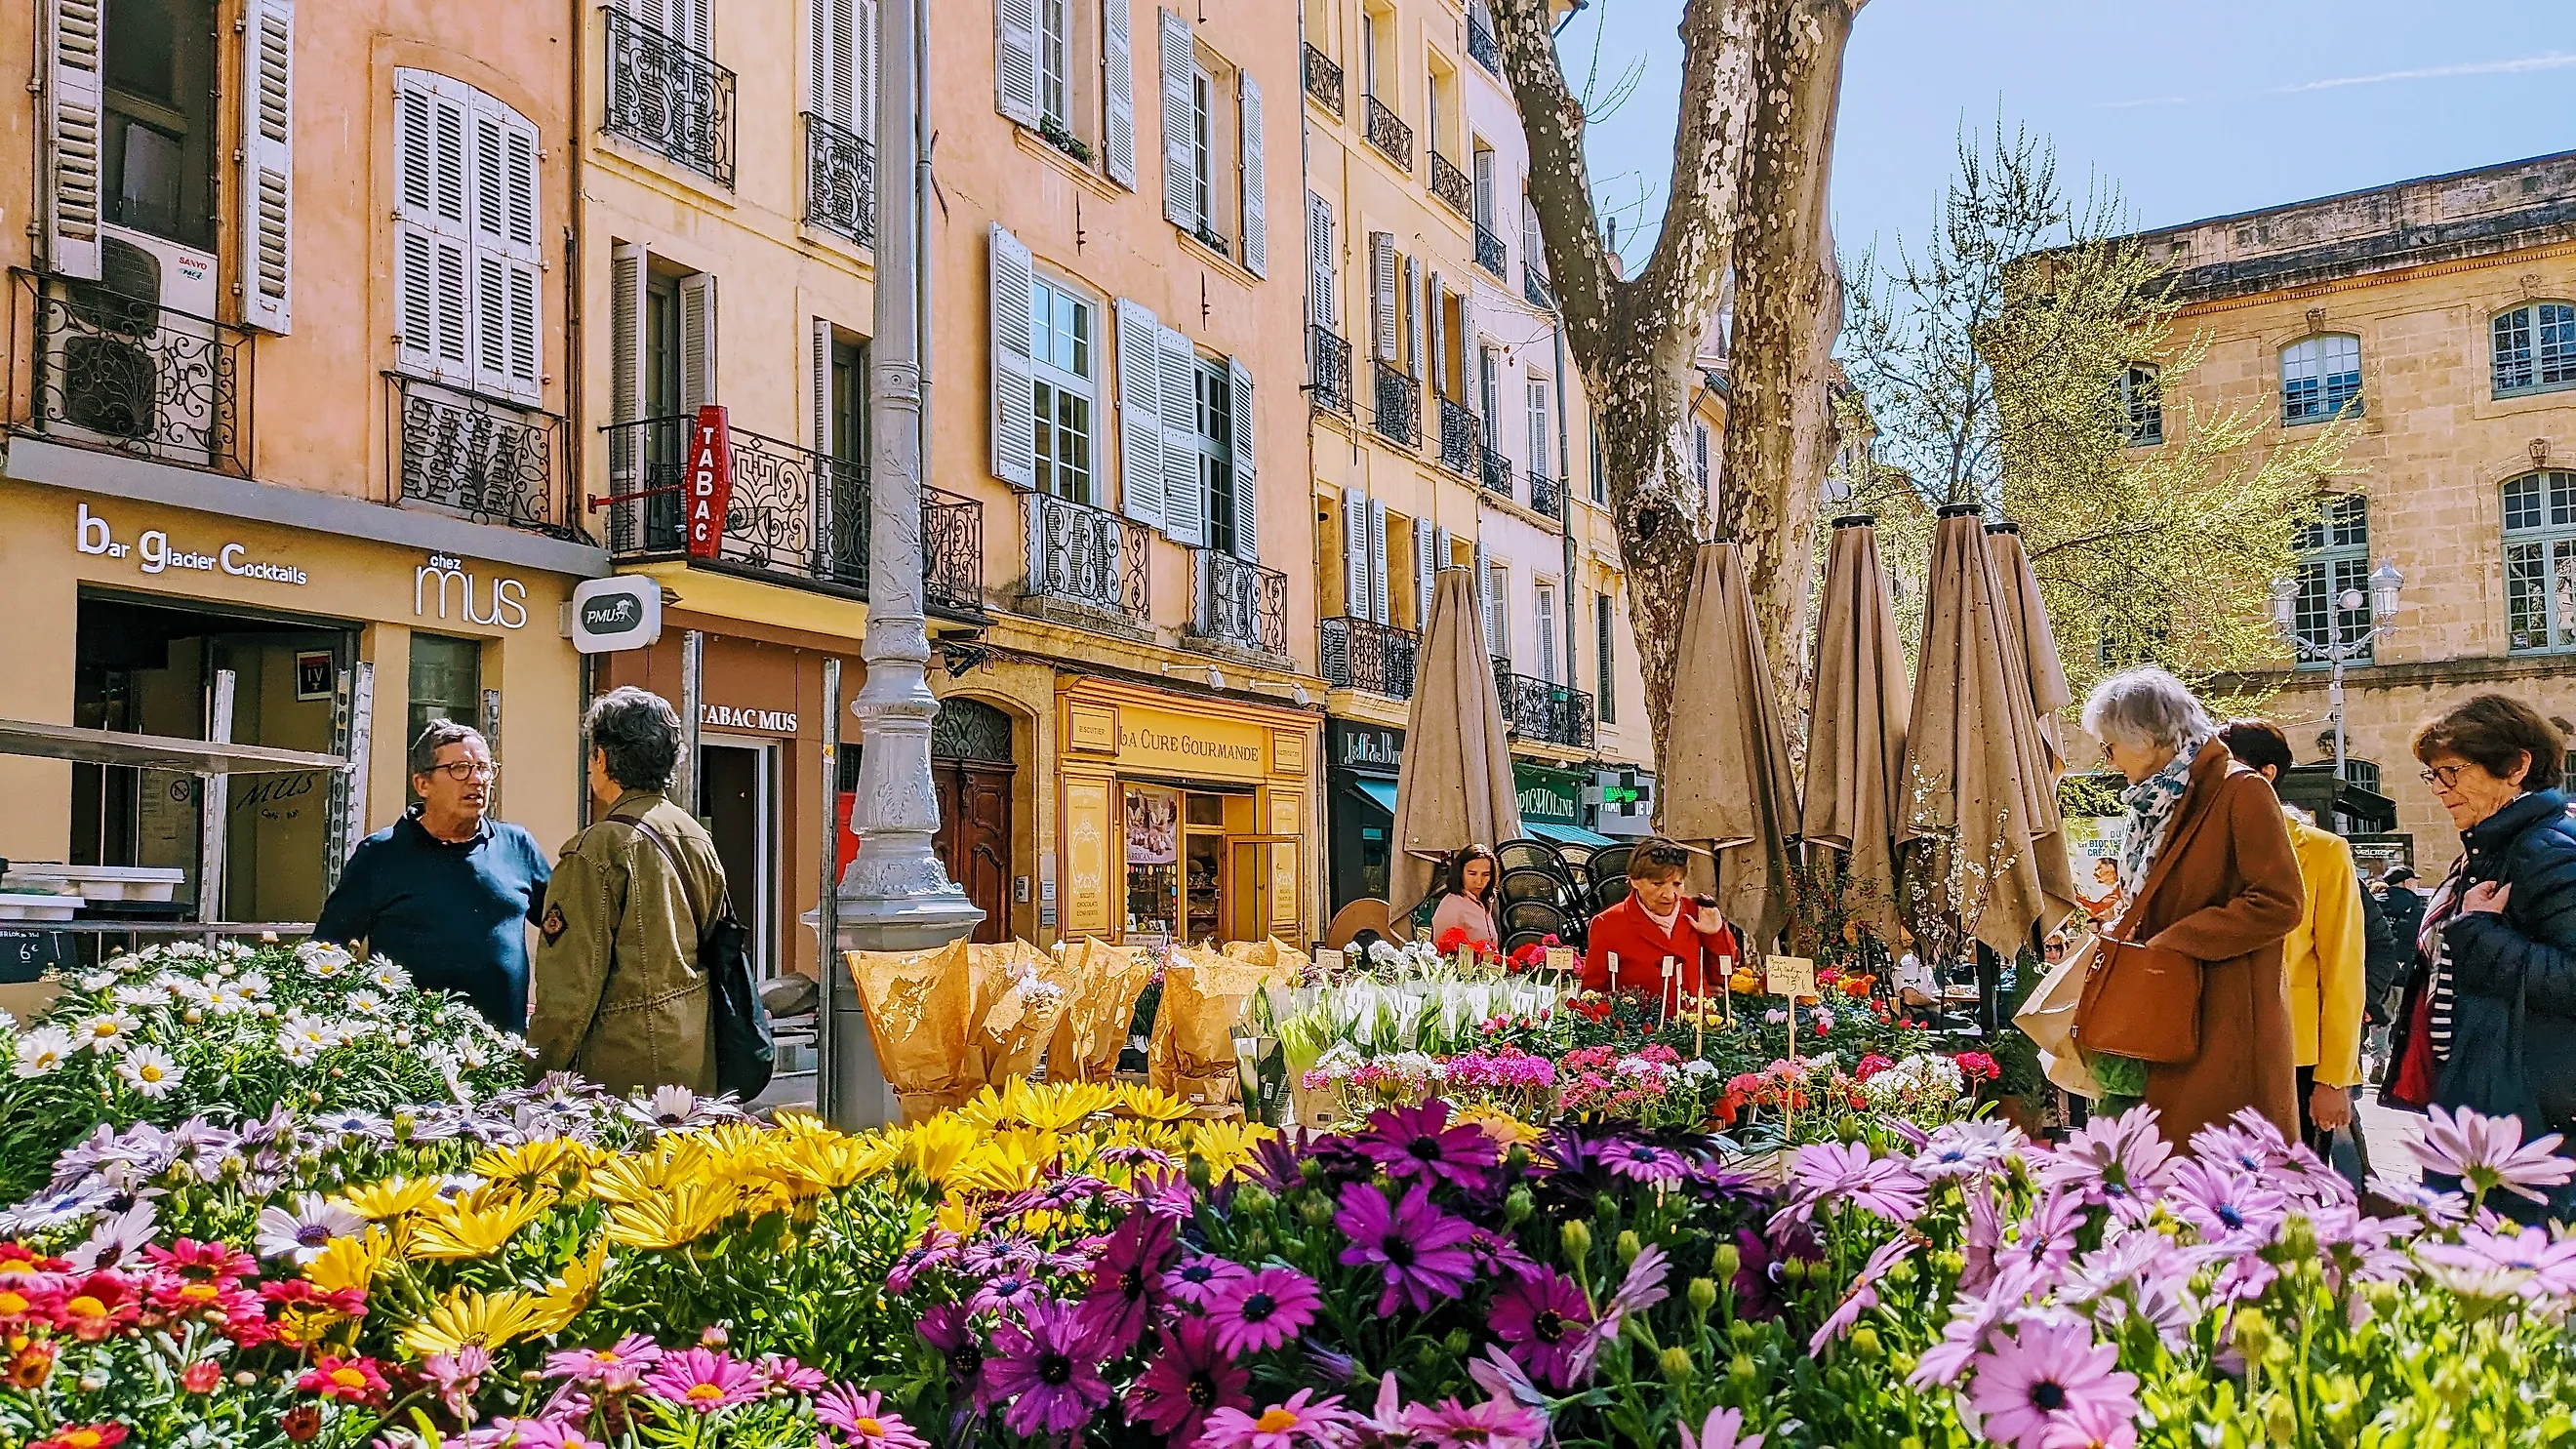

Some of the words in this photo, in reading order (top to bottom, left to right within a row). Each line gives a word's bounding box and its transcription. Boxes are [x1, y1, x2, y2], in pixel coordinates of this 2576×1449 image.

[179, 257, 208, 270] SANYO
[694, 427, 714, 541] TABAC
[219, 543, 308, 585] Cocktails
[429, 551, 463, 571] chez
[415, 565, 528, 629] mus
[586, 609, 617, 624] PMU
[701, 704, 757, 728] TABAC
[757, 710, 798, 732] MUS
[1119, 726, 1138, 747] LA
[1141, 728, 1179, 752] CURE
[1182, 735, 1259, 762] GOURMANDE
[1517, 787, 1575, 818] PICHOLINE
[1126, 851, 1153, 862] ABRICANT
